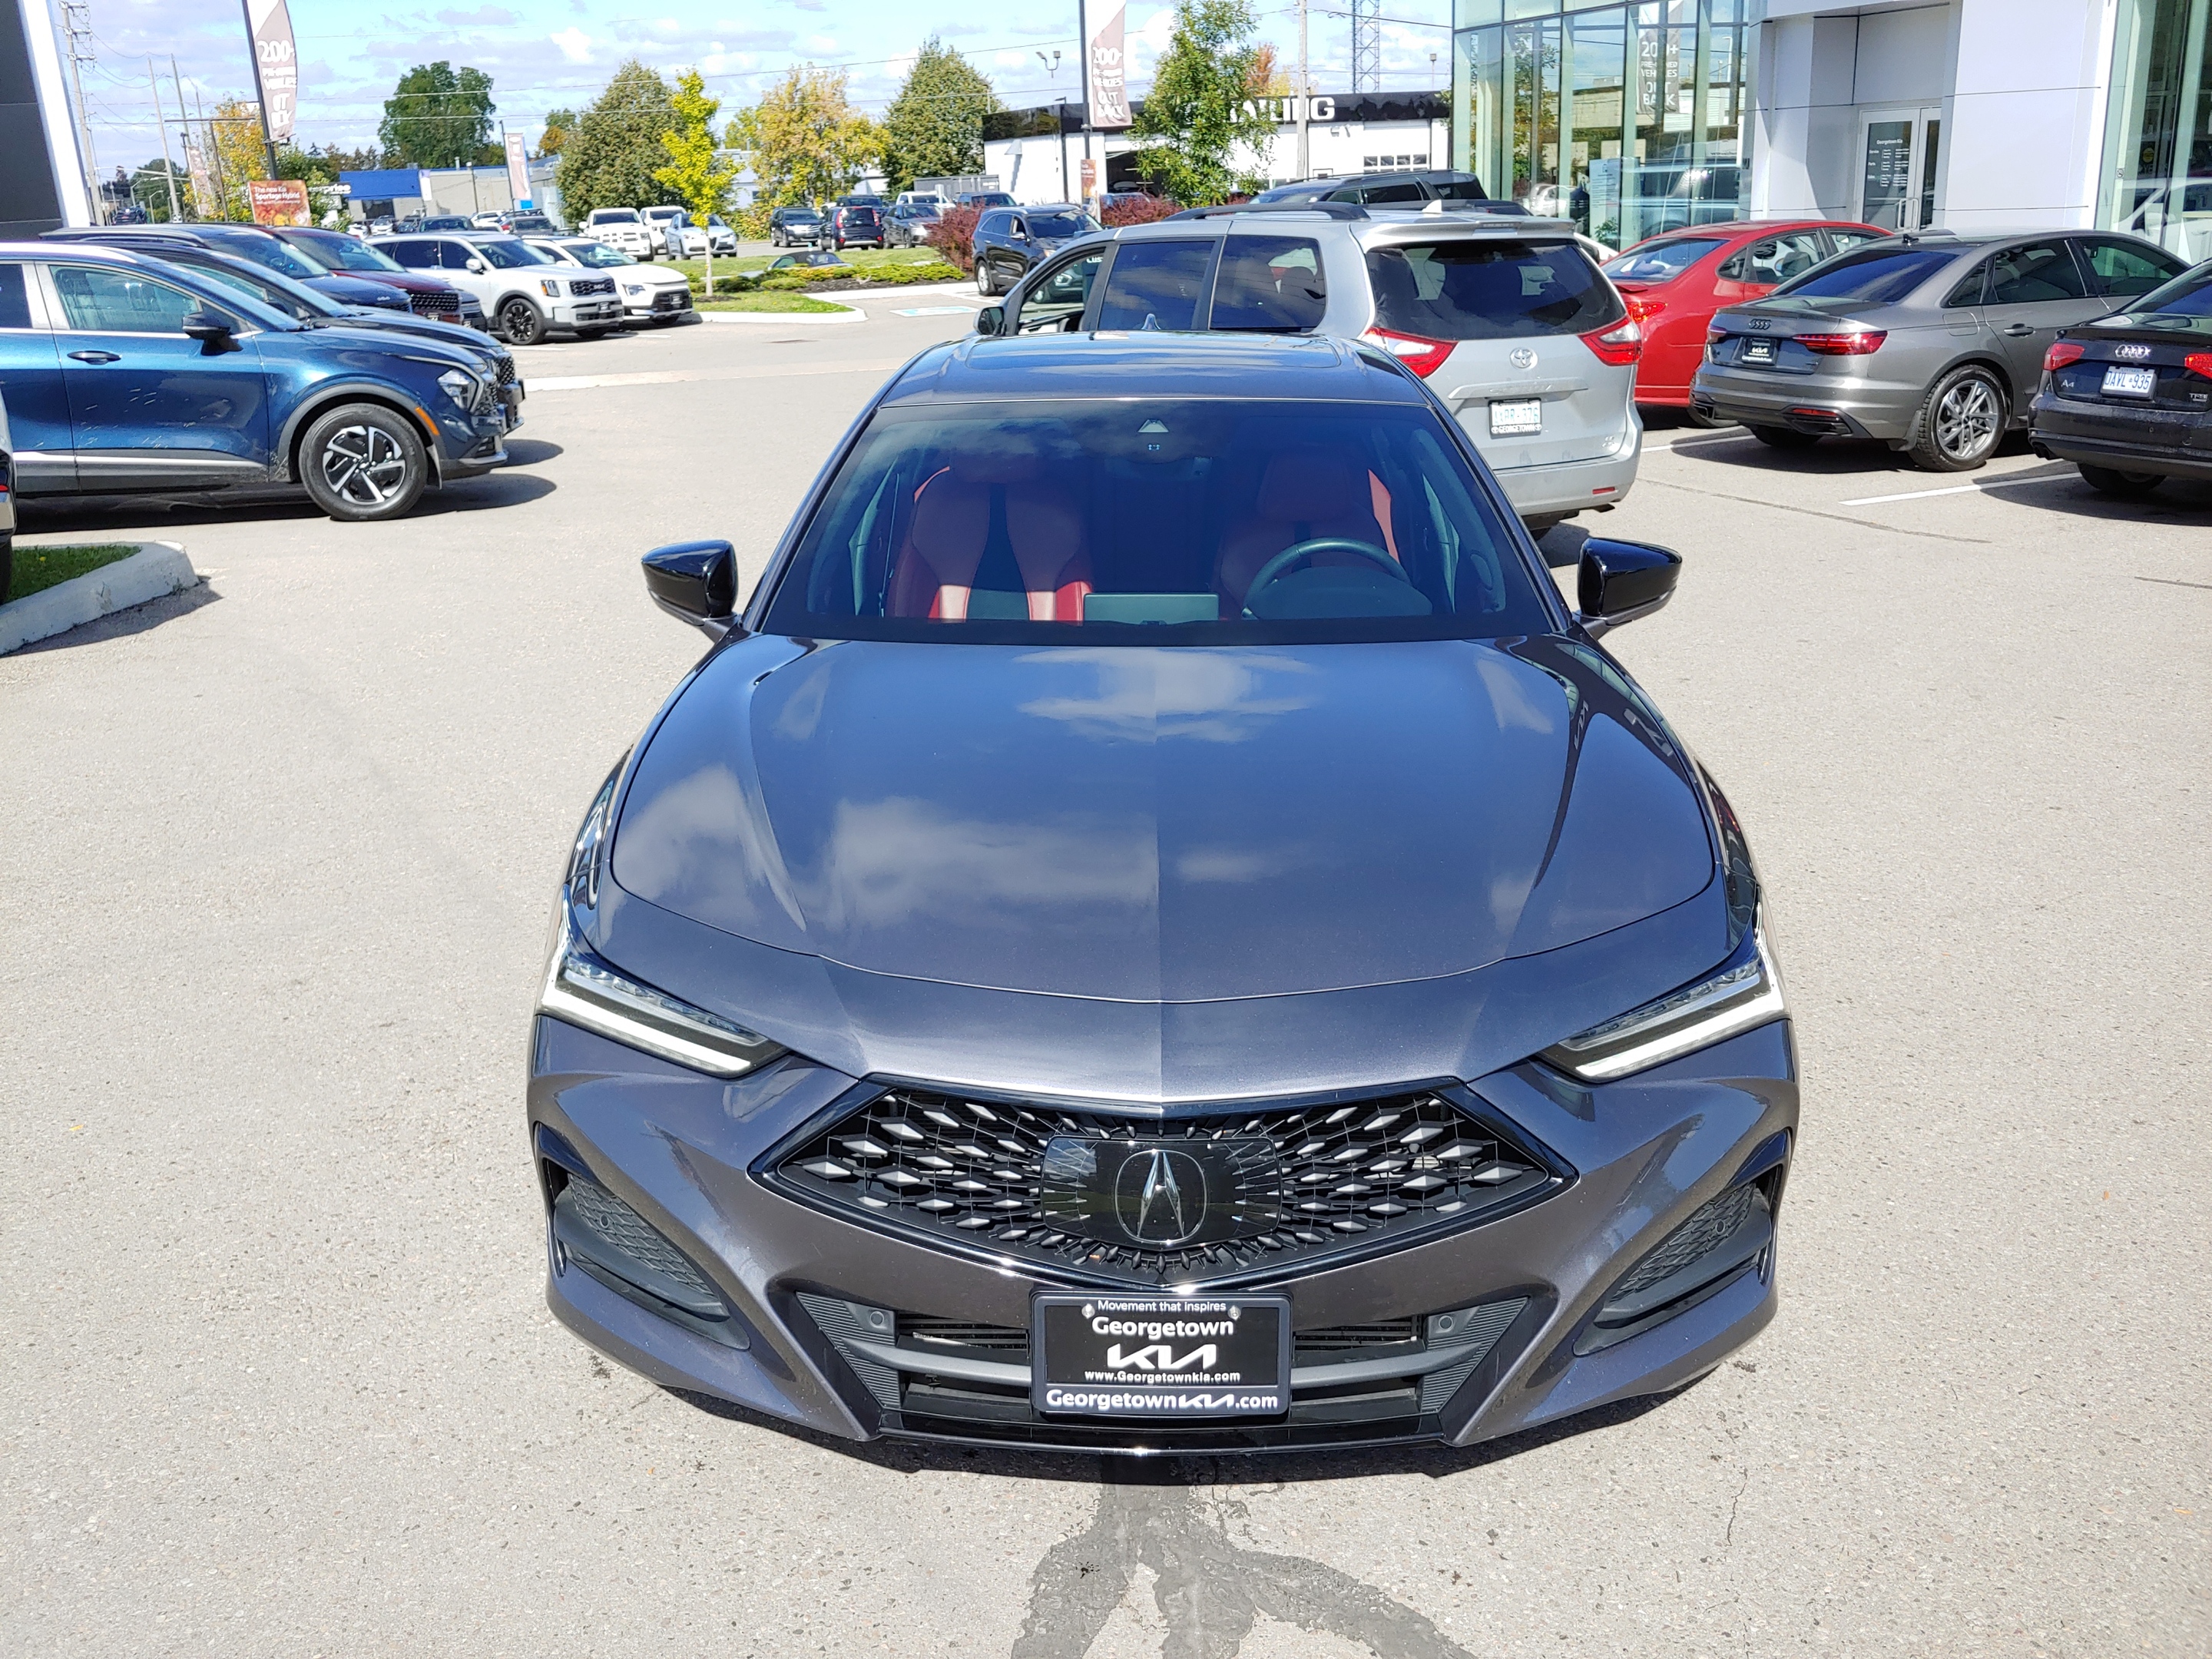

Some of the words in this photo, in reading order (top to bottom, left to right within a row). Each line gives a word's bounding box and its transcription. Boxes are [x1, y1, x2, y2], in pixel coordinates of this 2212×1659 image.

[1641, 41, 1678, 58] 20+
[1641, 68, 1677, 78] VEHES
[1643, 93, 1676, 105] BAK
[2061, 379, 2075, 388] A4
[1098, 1300, 1157, 1311] Movement
[1159, 1300, 1181, 1312] that
[1184, 1300, 1227, 1313] inspires
[1092, 1316, 1234, 1340] Georgetown
[1107, 1343, 1217, 1369] KIA
[1084, 1370, 1240, 1383] www.Georgetownkia.com
